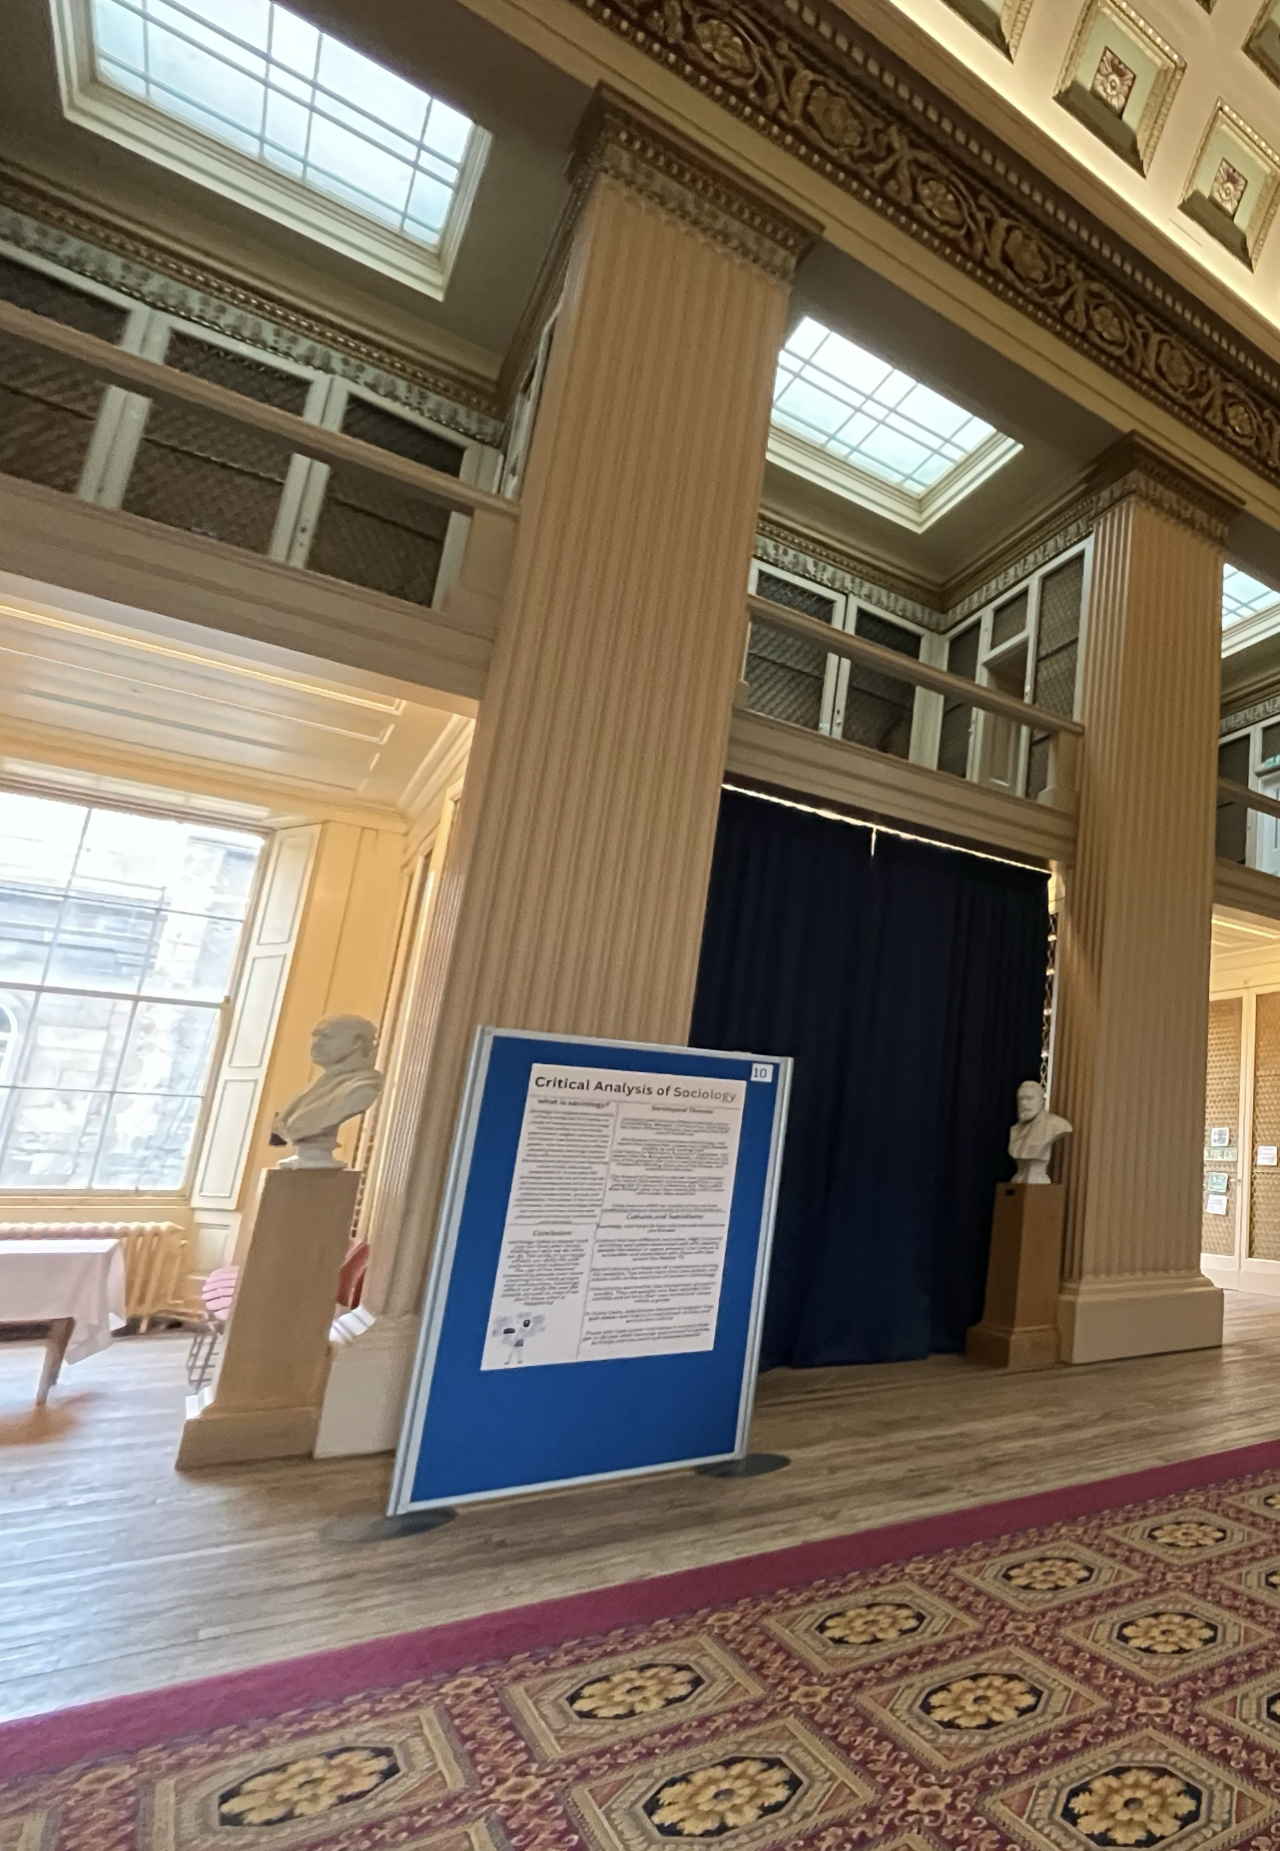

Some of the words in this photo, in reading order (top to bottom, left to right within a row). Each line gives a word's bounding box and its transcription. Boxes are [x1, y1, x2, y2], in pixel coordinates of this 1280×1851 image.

[753, 1067, 768, 1079] 10
[534, 1075, 590, 1091] Critical
[594, 1082, 653, 1096] Analysis
[656, 1086, 671, 1096] of
[673, 1087, 737, 1103] Sociology
